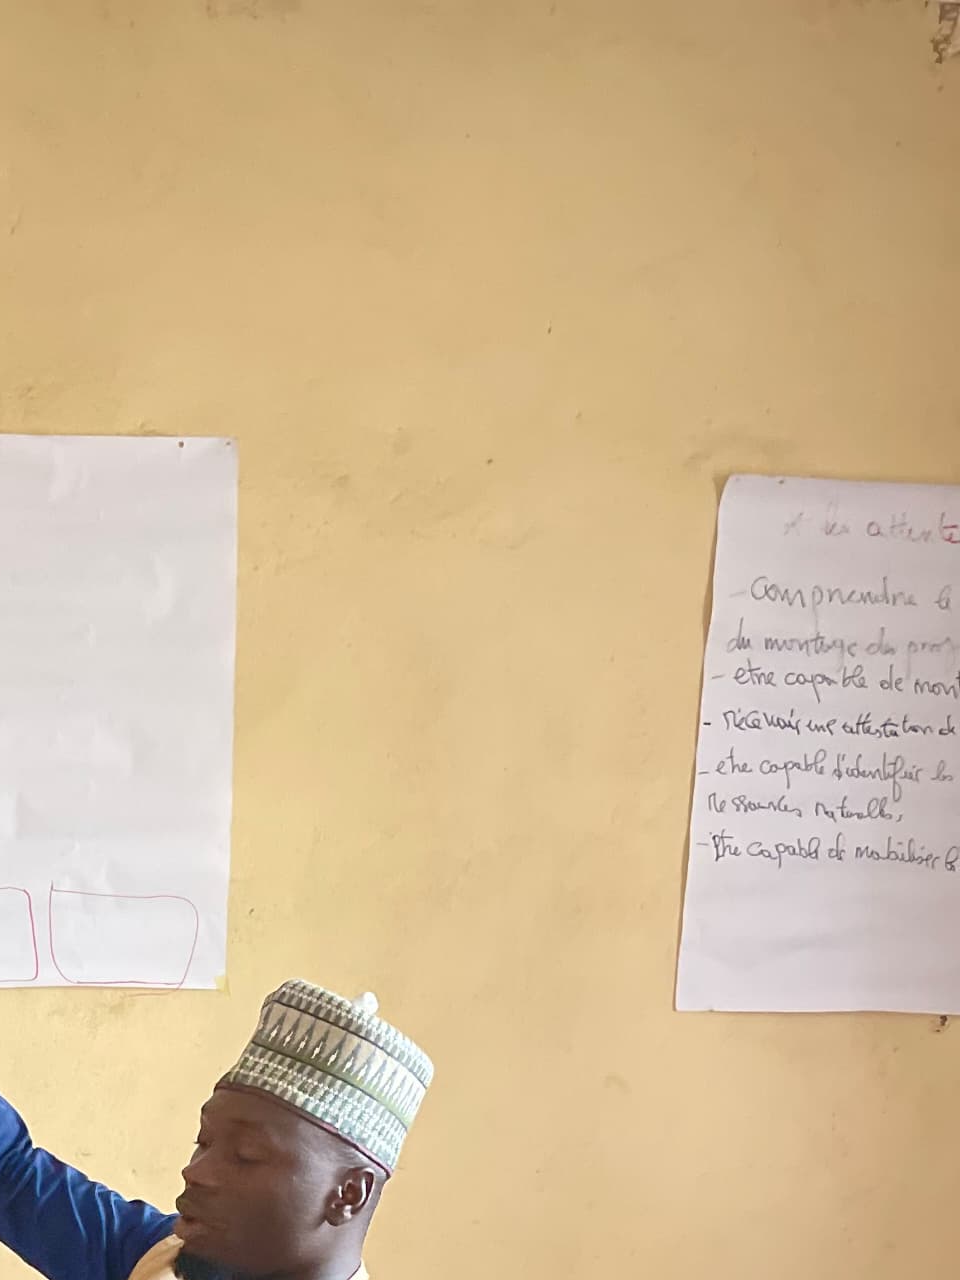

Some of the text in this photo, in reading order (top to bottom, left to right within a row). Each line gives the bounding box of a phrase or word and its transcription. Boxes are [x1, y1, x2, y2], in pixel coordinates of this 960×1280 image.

[784, 664, 869, 704] capable
[880, 665, 904, 692] de
[842, 711, 934, 739] attestation
[759, 748, 825, 790] capable
